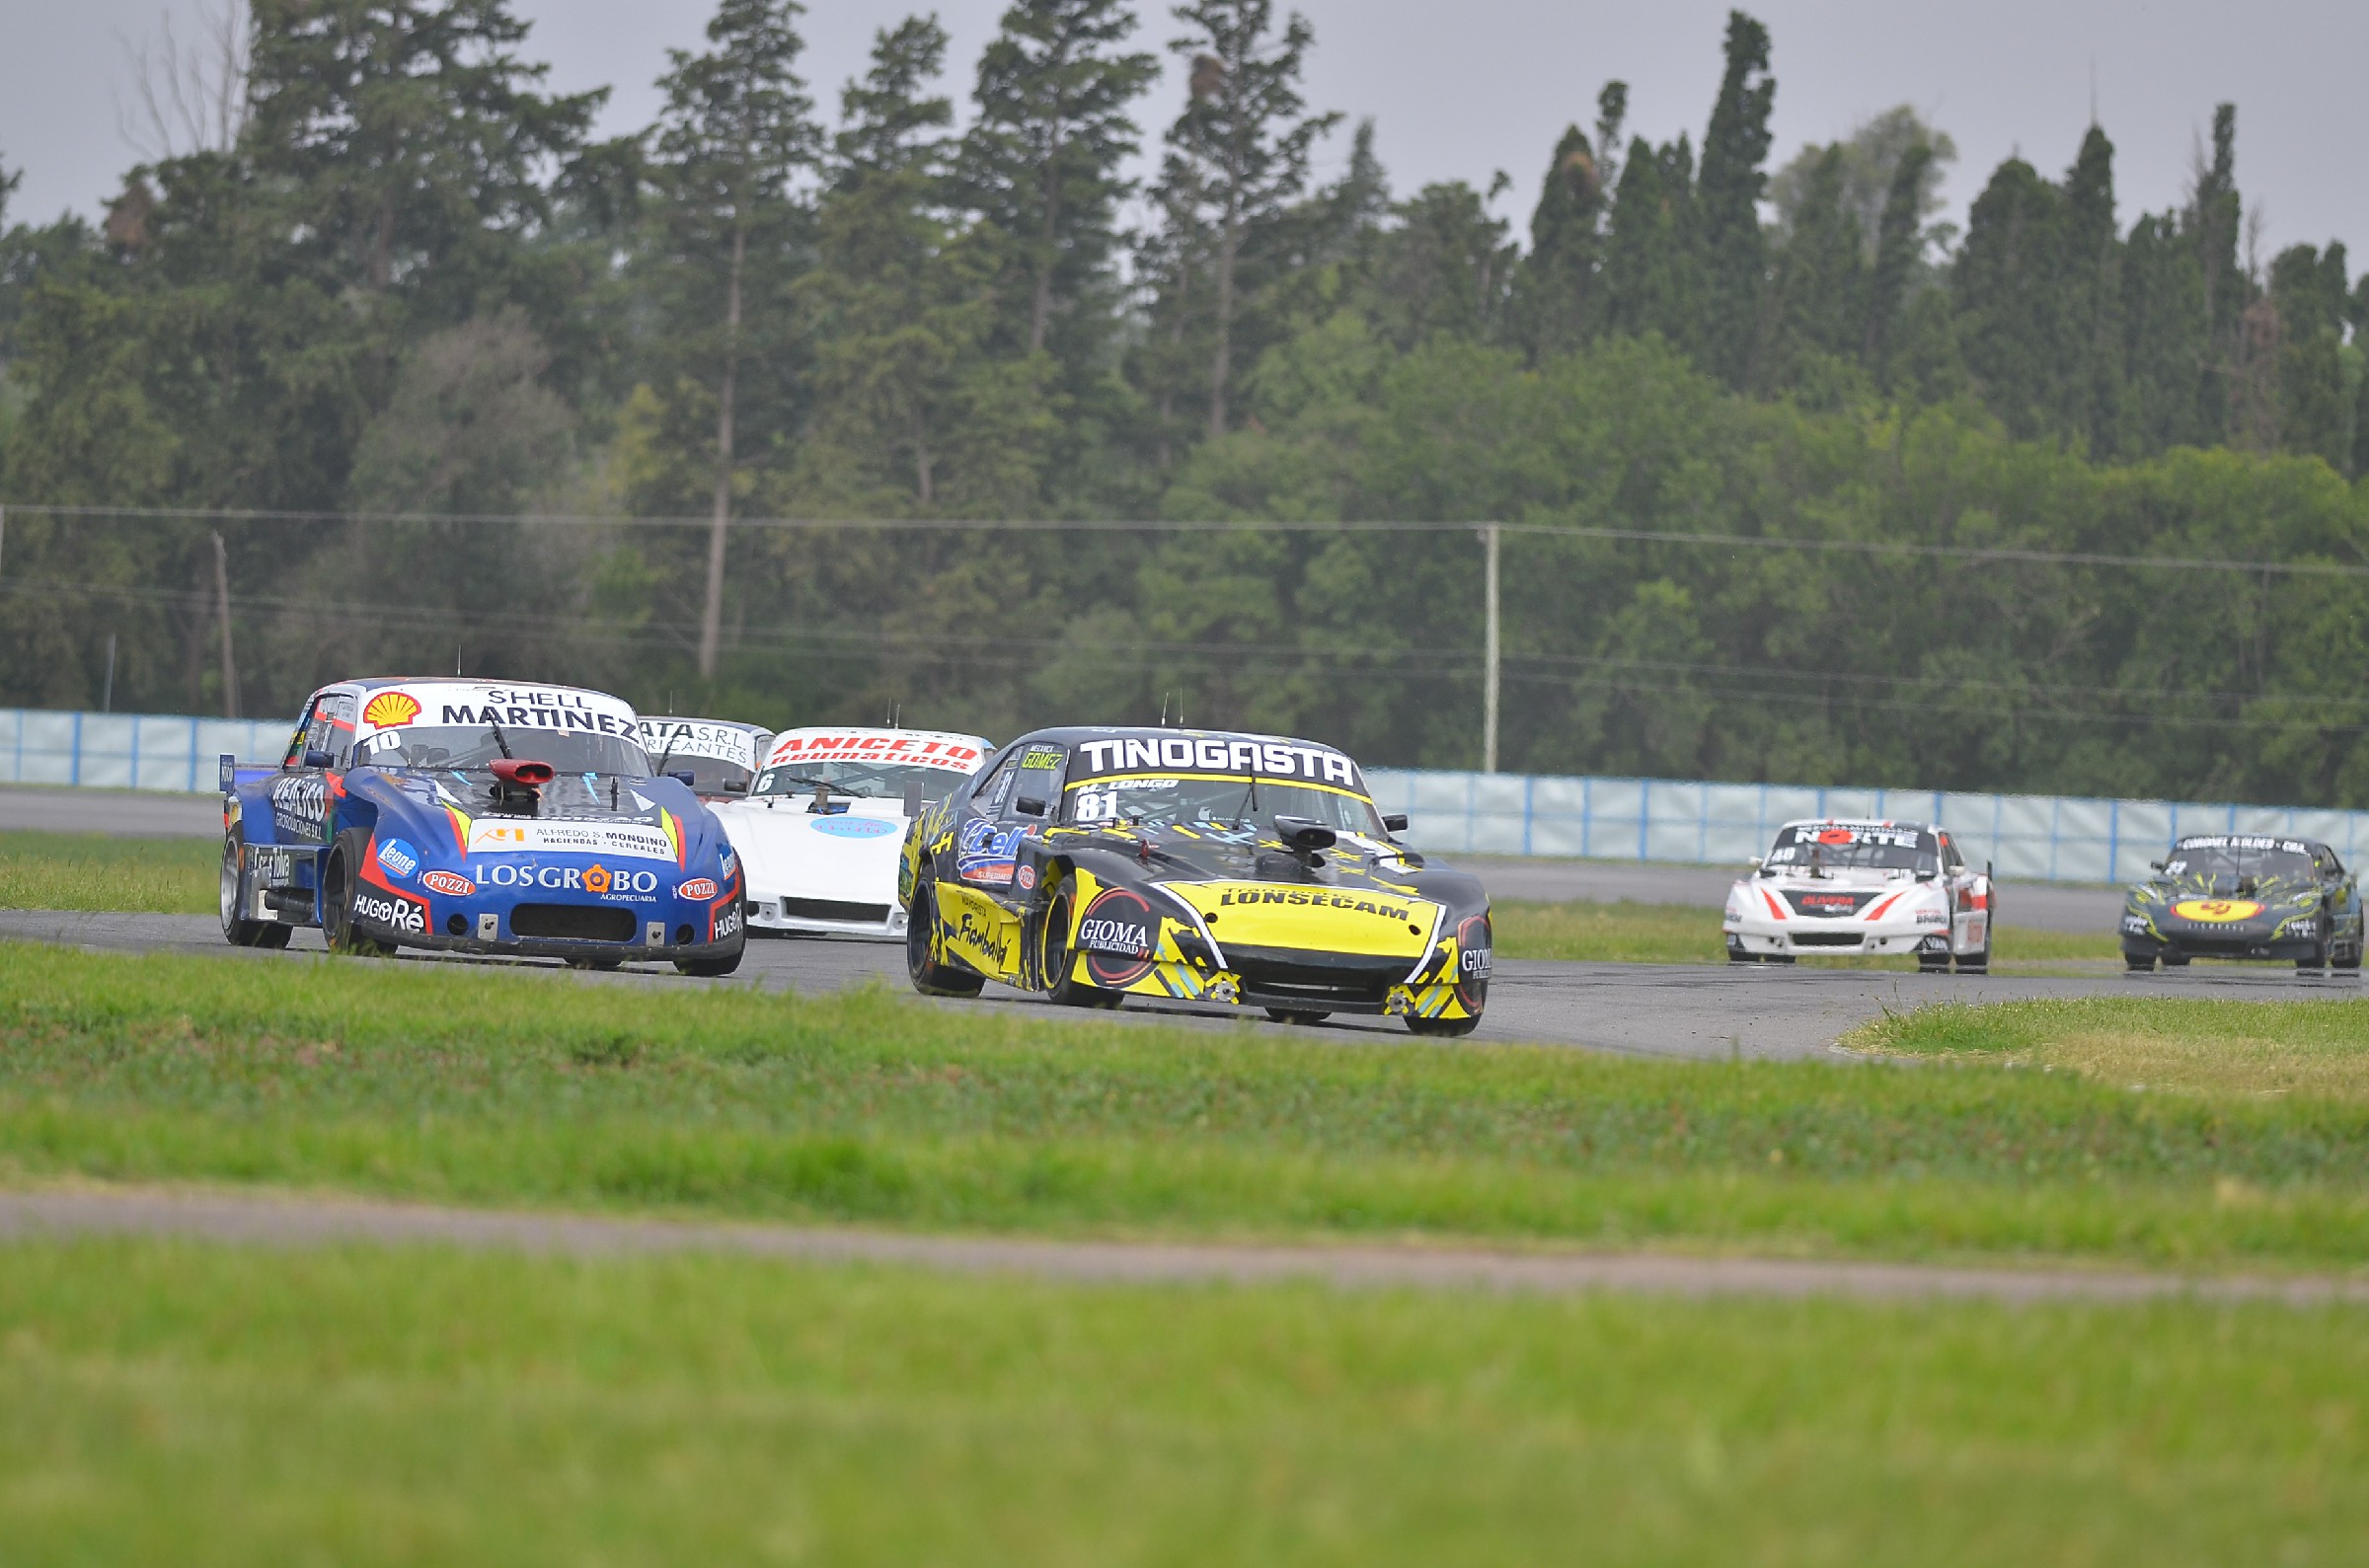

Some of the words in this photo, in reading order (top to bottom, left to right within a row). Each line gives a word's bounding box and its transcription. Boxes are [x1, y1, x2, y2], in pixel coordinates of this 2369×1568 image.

[488, 690, 593, 709] SHELL
[442, 705, 640, 744] MARTINEZ
[364, 730, 401, 756] 10
[697, 726, 746, 751] S.R.L.
[774, 737, 978, 761] ANICETO
[771, 752, 969, 770] neumaticos
[1022, 752, 1063, 770] GOMEZ
[1081, 738, 1354, 786] TINOGASTA
[757, 774, 775, 792] 6
[1108, 779, 1180, 791] LONGO
[1077, 789, 1117, 821] 81
[536, 827, 589, 838] ALFREDO
[593, 830, 604, 839] S.
[605, 832, 667, 848] MONDINO
[543, 837, 598, 846] HACIENDAS
[611, 841, 666, 855] CEREALES
[378, 839, 417, 870] Leone
[429, 873, 471, 894] POZZI
[686, 882, 716, 896] POZZI
[600, 893, 657, 903] AGROPECUARIA
[1220, 892, 1409, 921] LONSECAM
[1081, 919, 1148, 947] GIOMA
[1090, 939, 1139, 955] PUBLICIDAD
